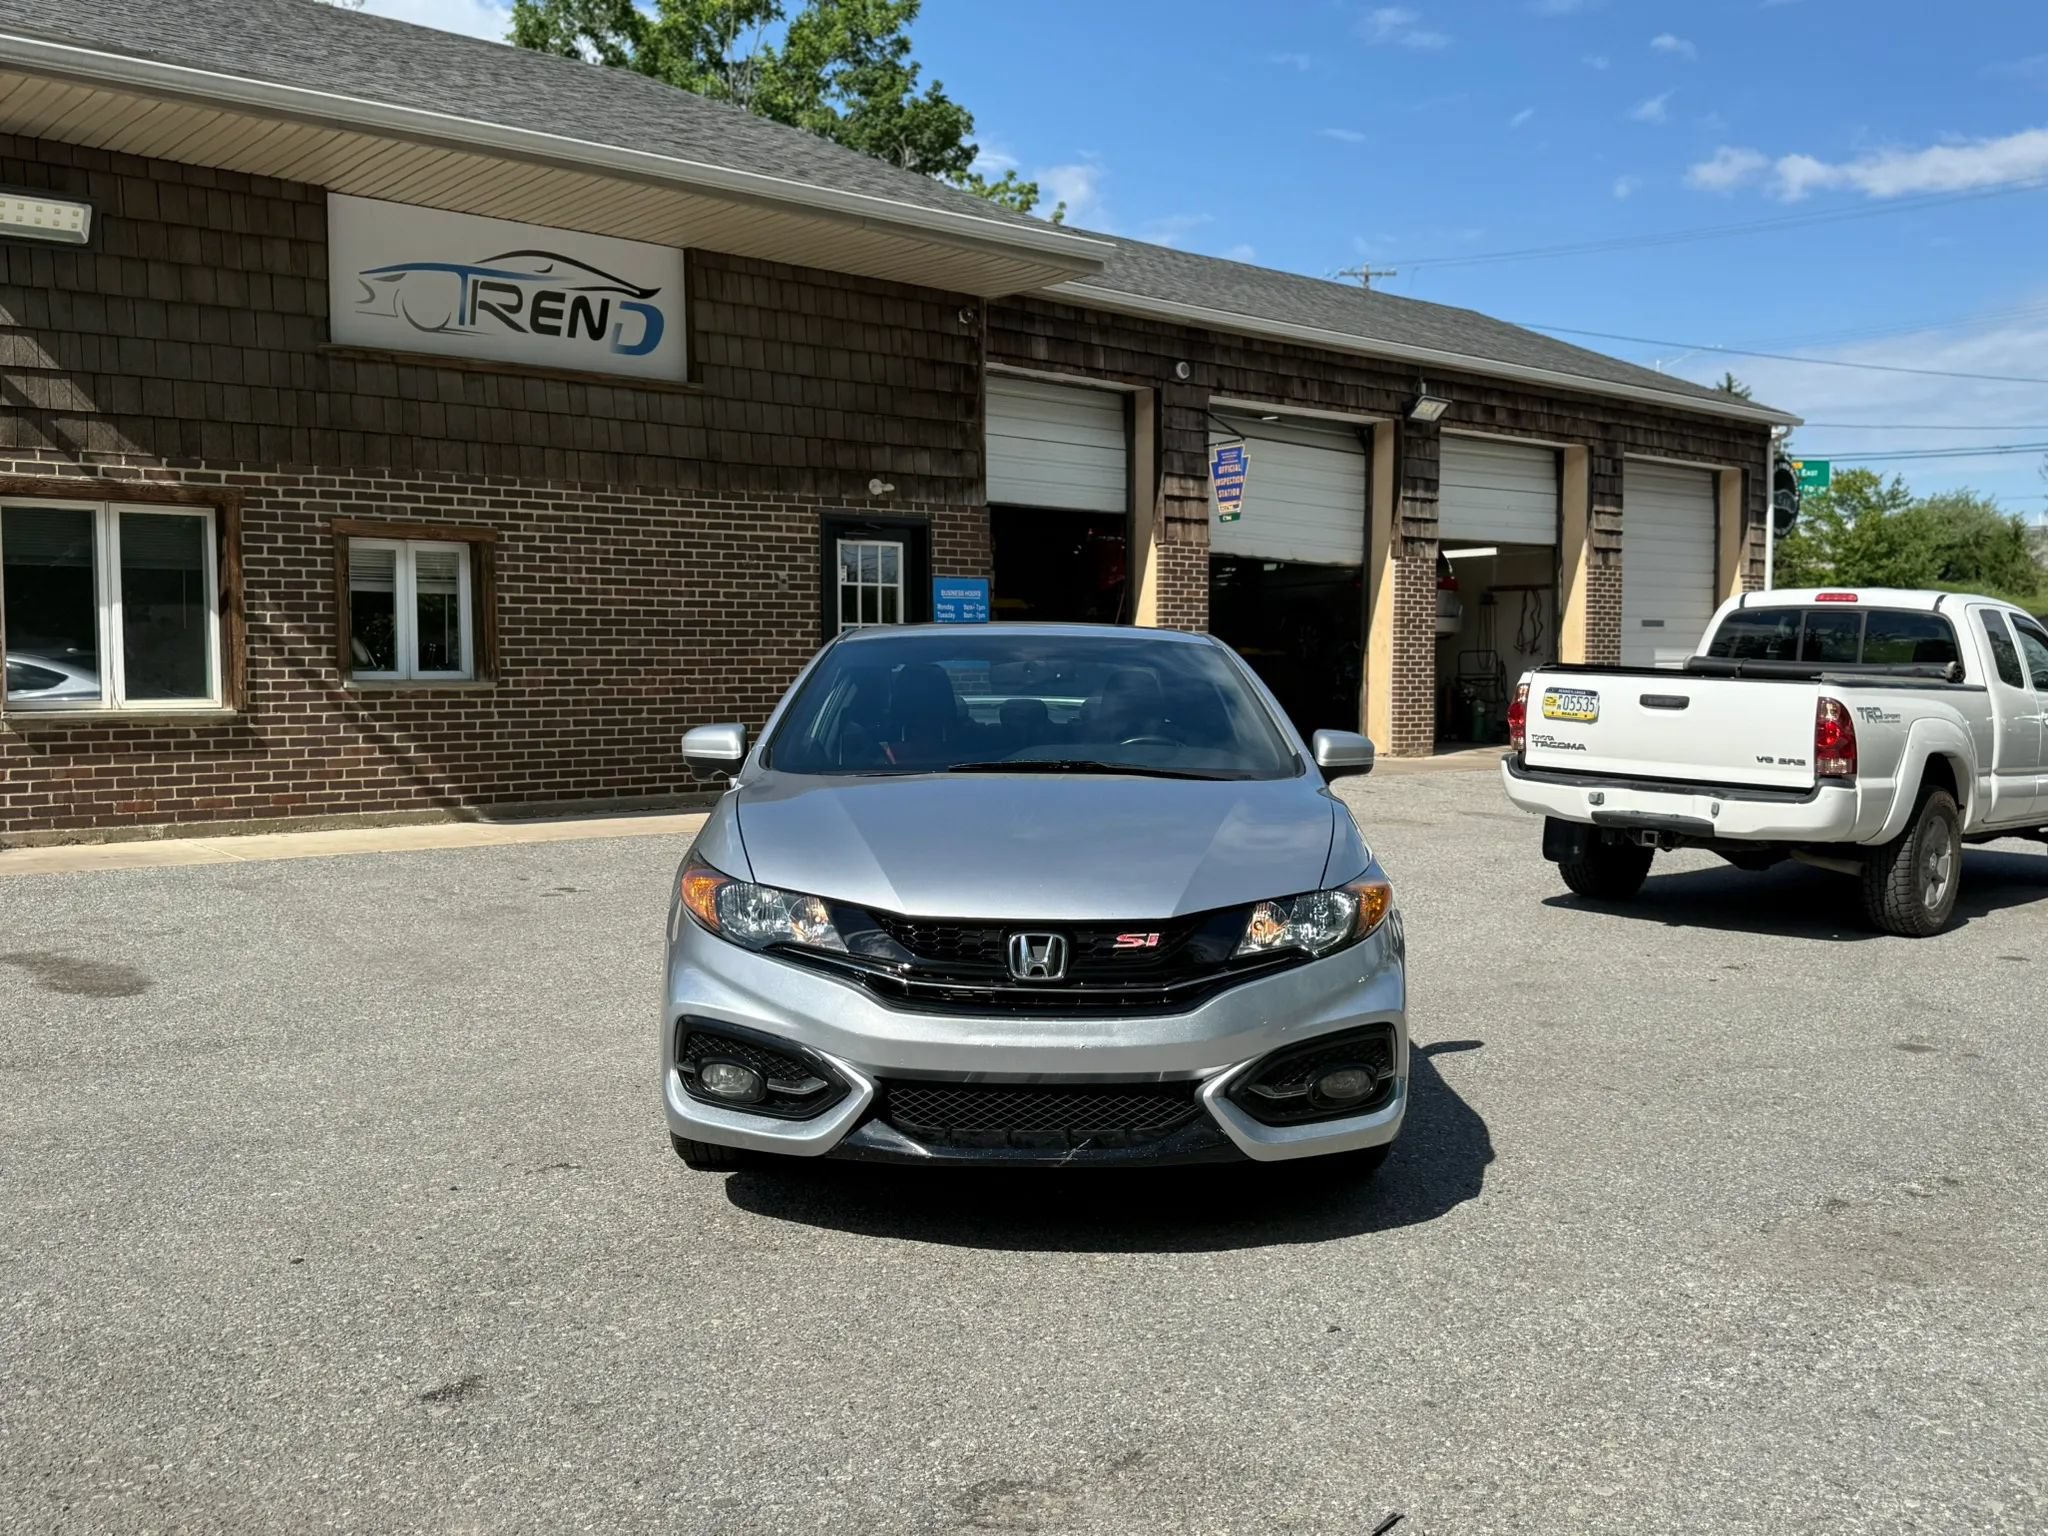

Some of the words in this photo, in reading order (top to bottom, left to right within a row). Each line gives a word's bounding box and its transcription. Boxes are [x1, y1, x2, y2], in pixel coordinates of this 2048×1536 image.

[440, 262, 665, 357] TREND
[1218, 464, 1242, 475] OFFICIAL
[1215, 475, 1244, 487] INSPECTION
[1218, 488, 1240, 498] STATION
[941, 589, 964, 597] BUSINESS
[937, 603, 954, 611] Monday
[937, 612, 955, 620] Tuesday
[1563, 695, 1596, 712] 05535
[1856, 706, 1883, 724] TRD
[1531, 733, 1555, 741] TOYOTA
[1531, 740, 1587, 751] TACOMA
